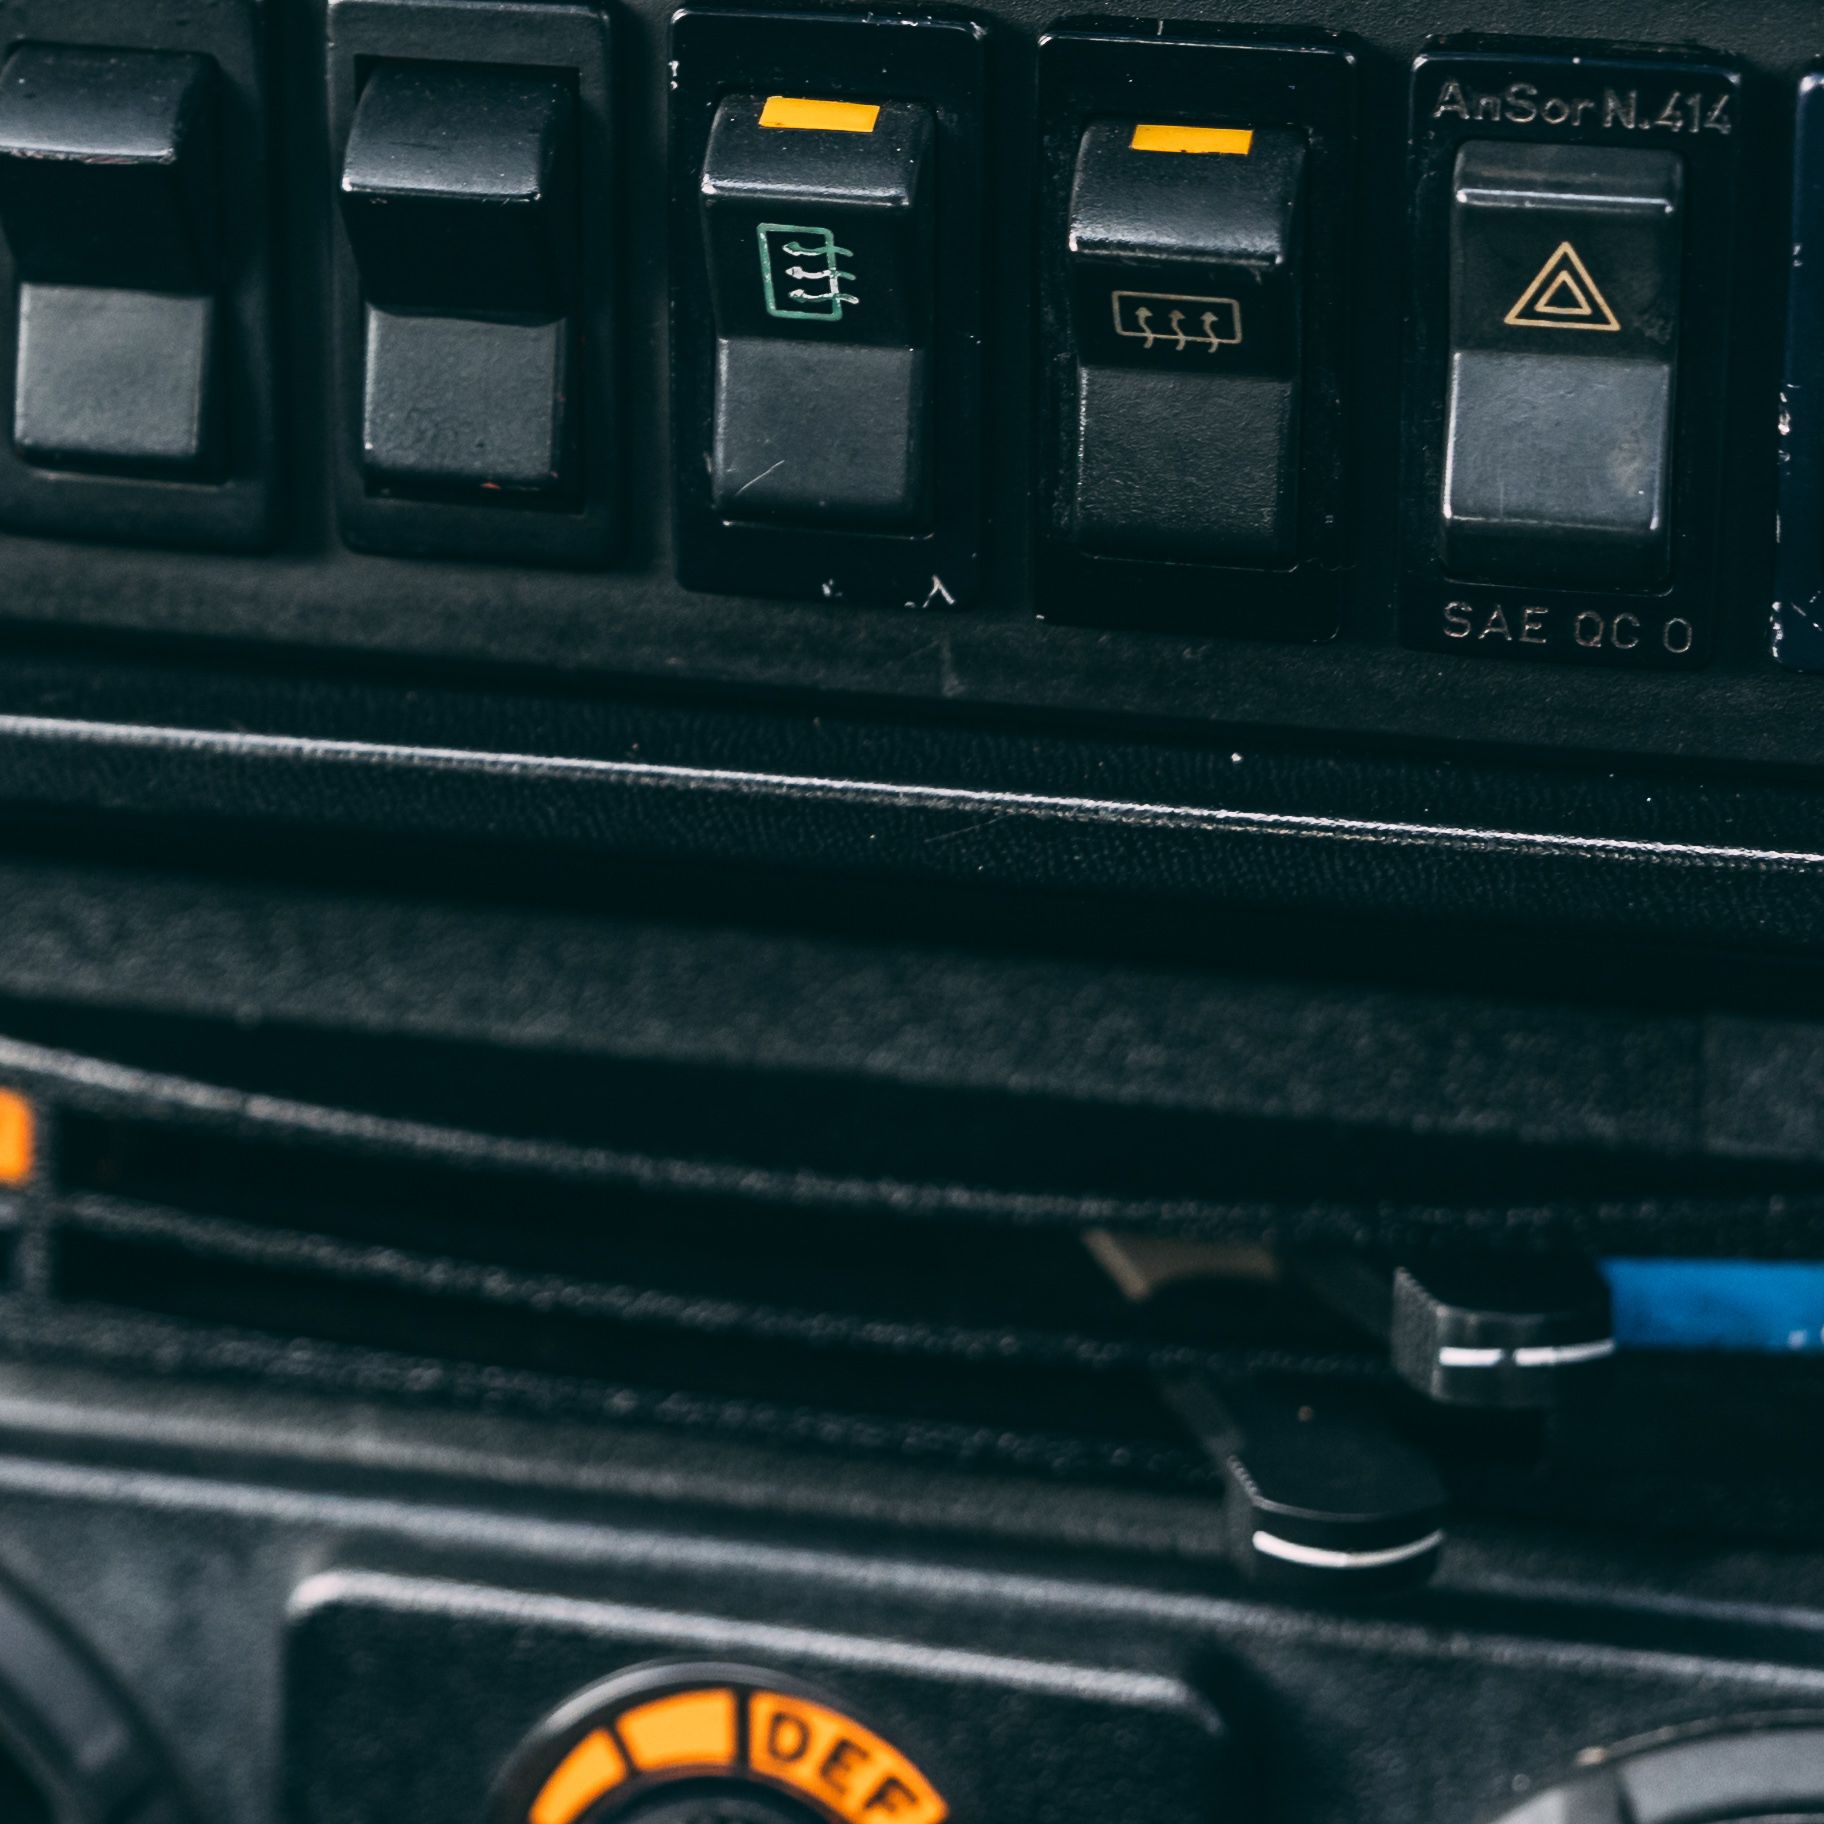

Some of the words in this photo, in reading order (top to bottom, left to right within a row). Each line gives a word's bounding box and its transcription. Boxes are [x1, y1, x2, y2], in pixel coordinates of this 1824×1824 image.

[1443, 600, 1549, 645] SAE
[1576, 610, 1641, 649] QC
[768, 1712, 918, 1813] DEF
